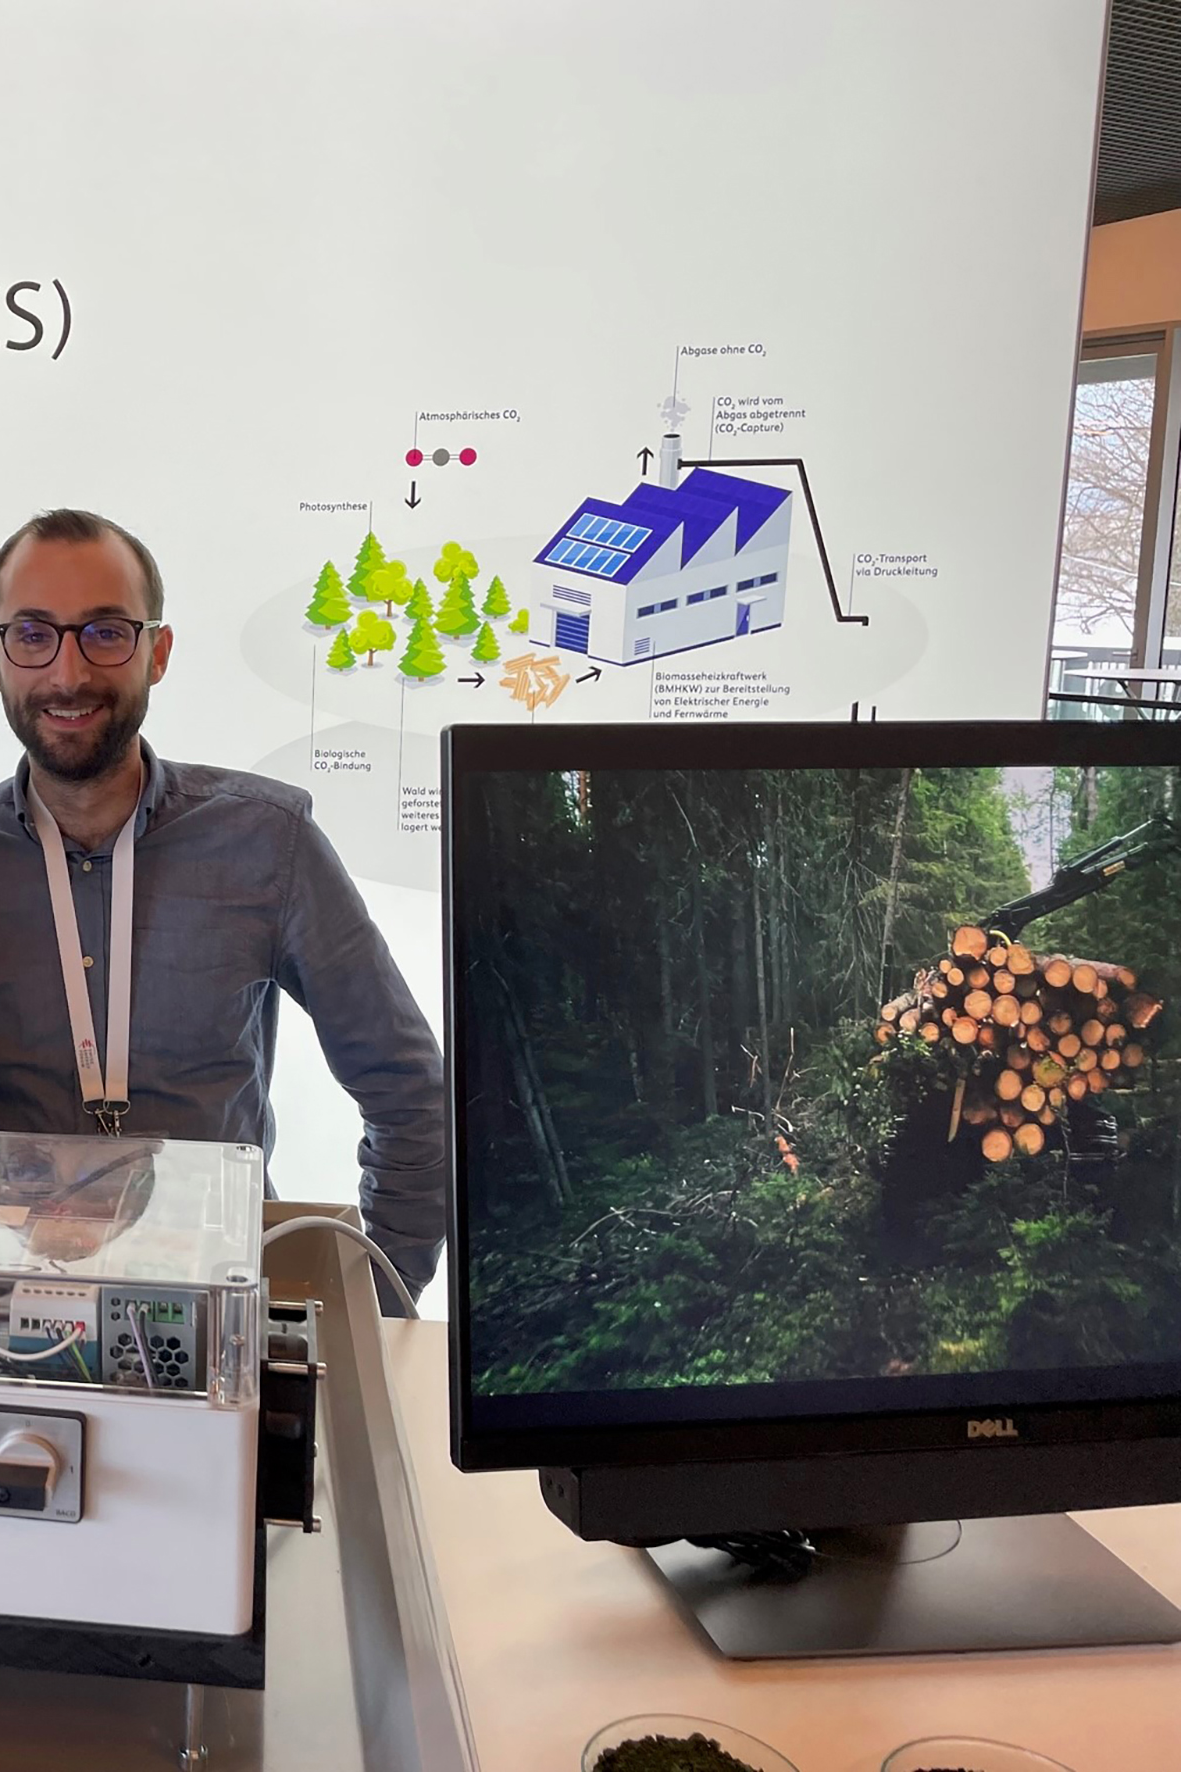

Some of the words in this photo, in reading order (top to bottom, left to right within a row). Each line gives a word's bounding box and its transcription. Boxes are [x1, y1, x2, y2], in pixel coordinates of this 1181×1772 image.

[680, 346, 718, 357] Abgase
[720, 345, 745, 355] ohne
[738, 397, 759, 406] wird
[762, 397, 783, 405] vom
[419, 411, 501, 421] Atmosphärisches
[716, 411, 747, 421] Abgas
[749, 409, 806, 421] abgetrennt
[299, 502, 367, 512] Photosynthese
[856, 567, 871, 576] via
[874, 566, 938, 577] Druckleitung
[655, 672, 767, 681] Biomasseheizkraftwerk
[654, 684, 702, 694] (BMHKW)
[705, 685, 720, 693] zur
[722, 684, 790, 695] Bereitstellung
[654, 698, 671, 706] von
[674, 697, 730, 706] Elektrischer
[733, 697, 769, 708] Energie
[653, 709, 671, 718] und
[674, 709, 728, 718] Fernwärme
[314, 749, 366, 760] Biologische
[402, 787, 425, 796] Wald
[401, 812, 440, 820] weiteres
[401, 824, 428, 833] lagert
[967, 1418, 1019, 1438] DELL
